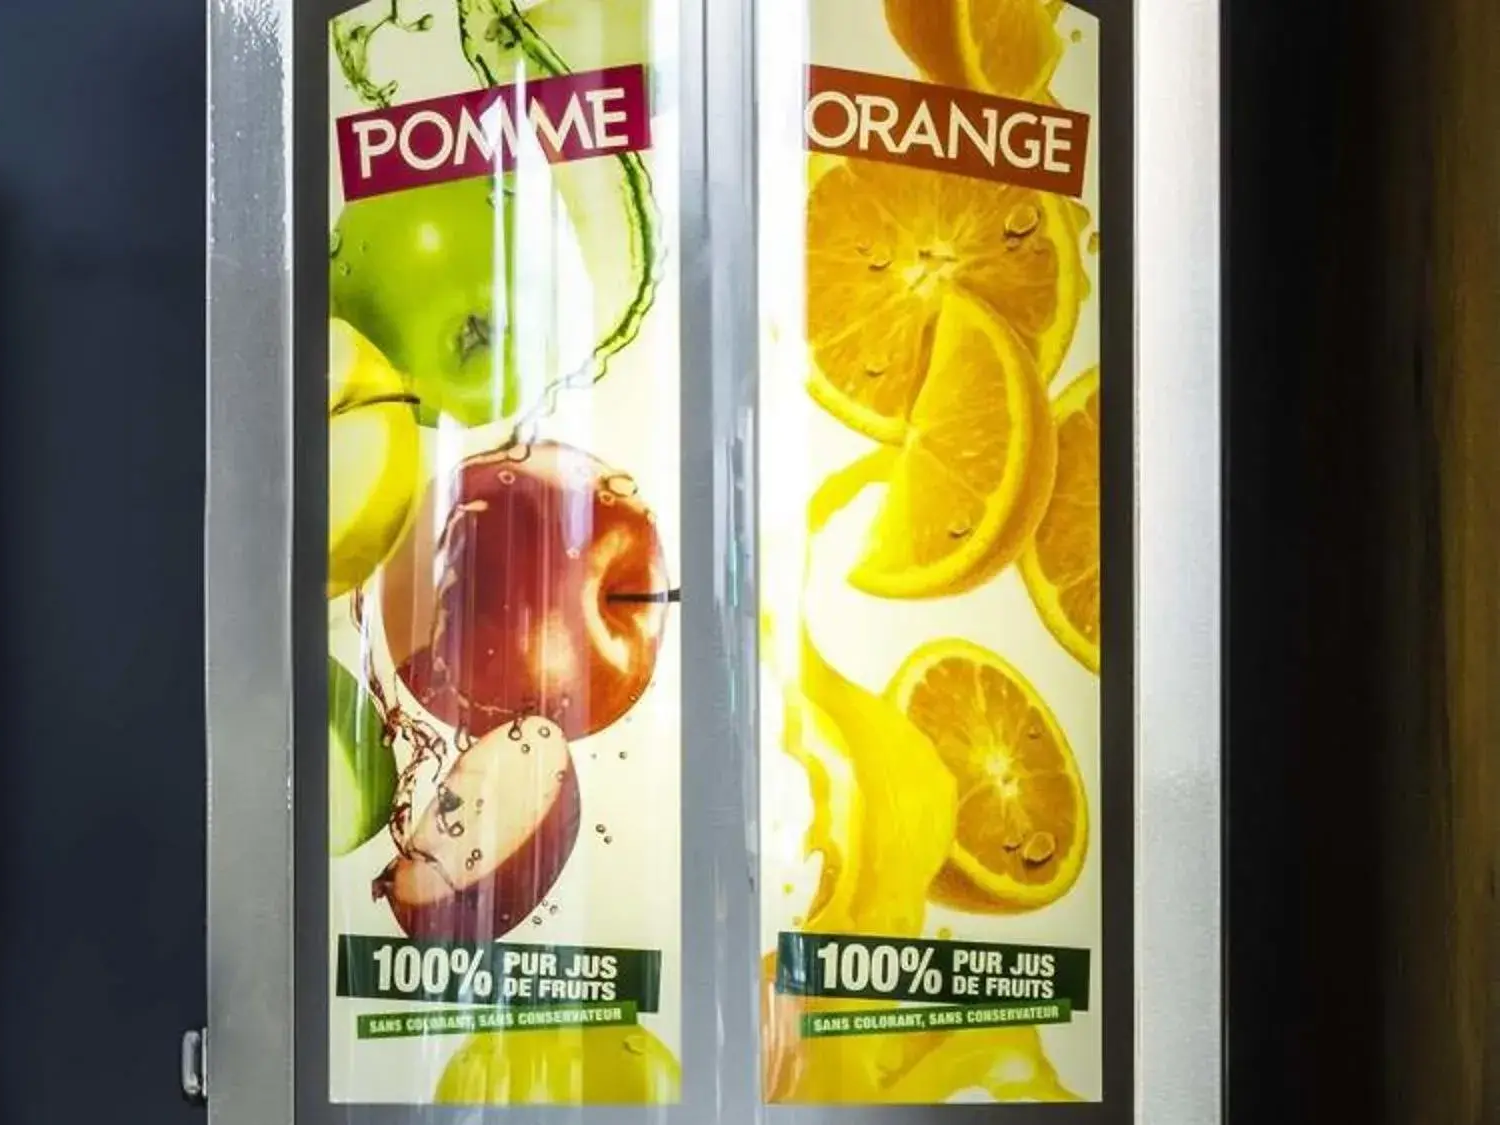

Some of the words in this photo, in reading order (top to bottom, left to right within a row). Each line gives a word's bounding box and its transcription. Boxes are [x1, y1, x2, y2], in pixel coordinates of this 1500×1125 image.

[352, 87, 629, 179] POMME
[805, 90, 1073, 174] ORANGE
[373, 944, 493, 997] 100%
[503, 951, 556, 976] PUR
[564, 954, 618, 979] JUS
[818, 942, 943, 994] 100%
[953, 949, 1002, 974] PUR
[1010, 952, 1055, 977] JUS
[503, 977, 533, 997] DE
[539, 979, 616, 1000] FRUITS
[953, 975, 979, 995] DE
[986, 976, 1054, 998] FRUITS
[369, 1018, 401, 1033] SANS
[479, 1012, 514, 1027] SANS
[518, 1008, 622, 1025] CONSERVATEUR
[813, 1017, 849, 1032] SANS
[854, 1013, 925, 1030] COLORANT,
[929, 1010, 962, 1025] SANS
[967, 1005, 1059, 1023] CONSERVATEUR
